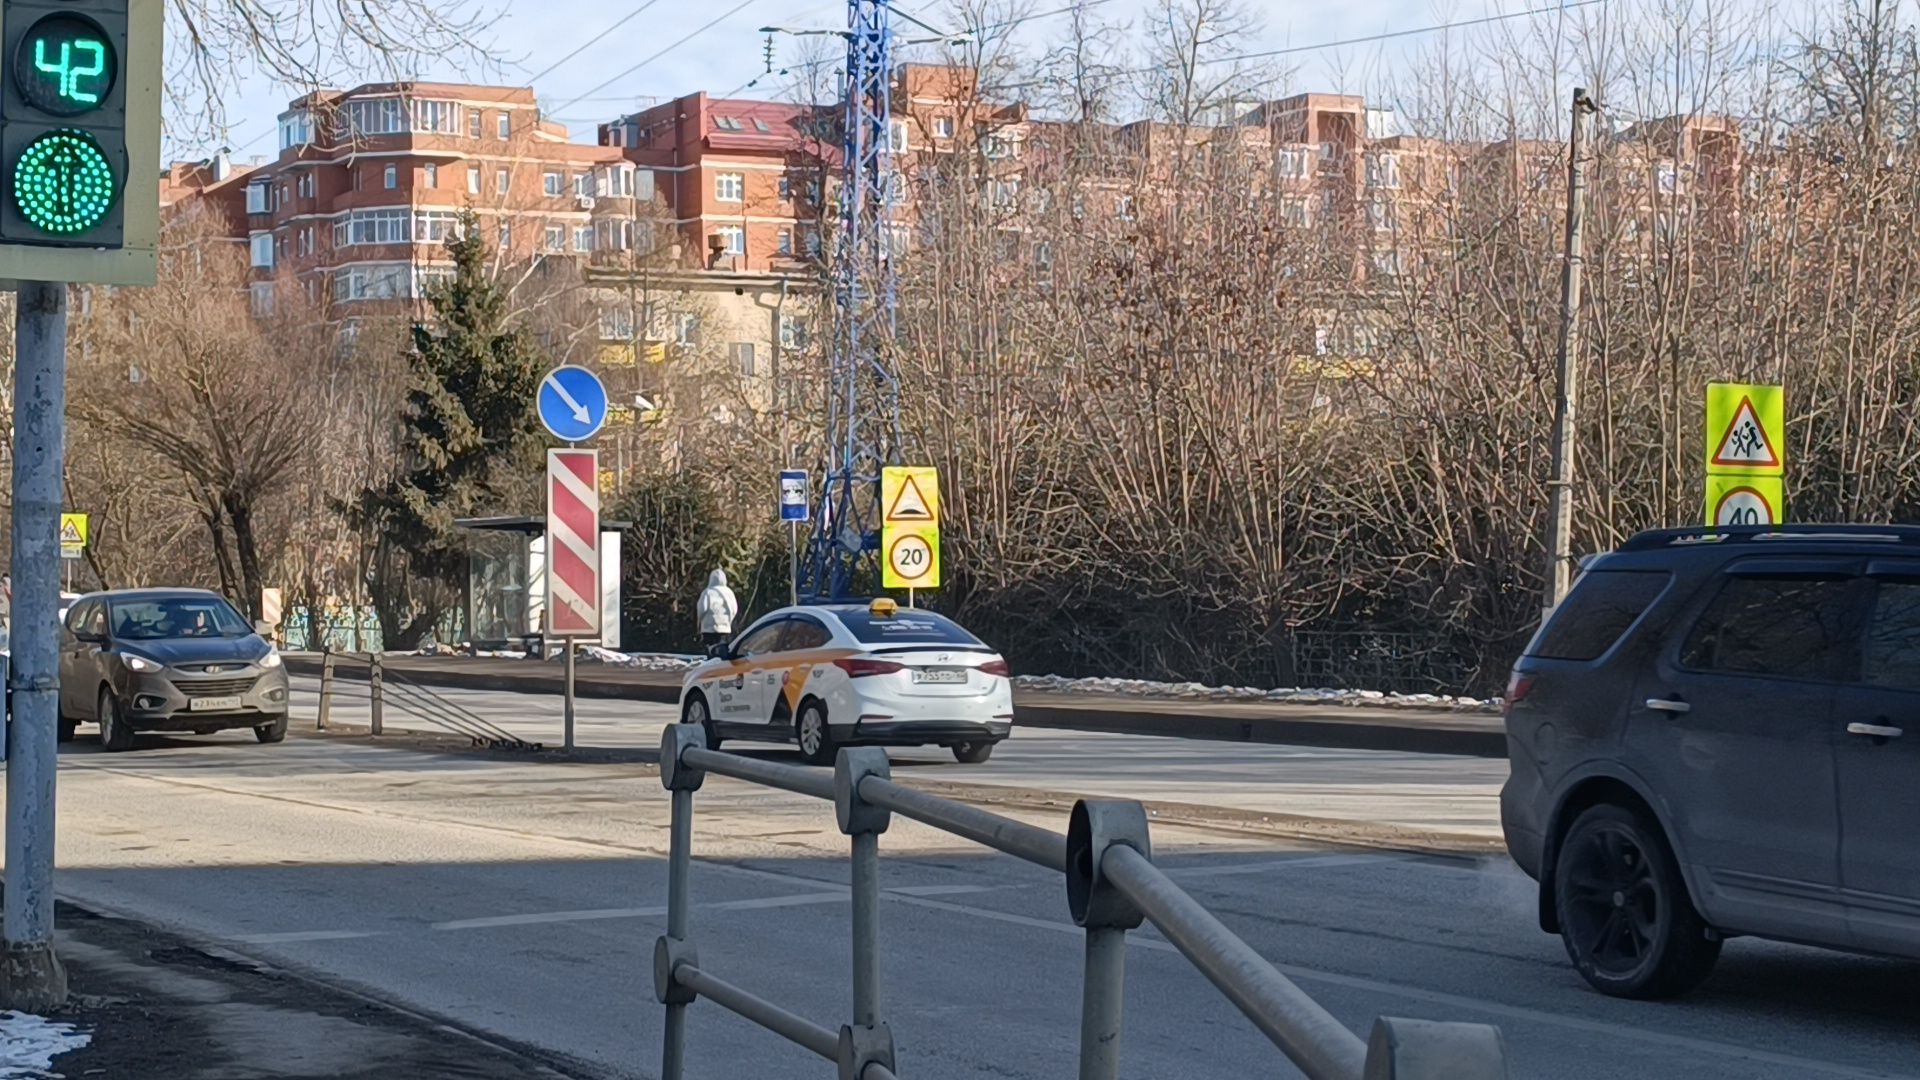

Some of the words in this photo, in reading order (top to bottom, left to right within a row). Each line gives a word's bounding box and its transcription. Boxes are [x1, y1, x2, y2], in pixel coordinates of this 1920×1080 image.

[35, 39, 104, 102] 42
[1729, 507, 1758, 525] 40
[900, 548, 922, 565] 20
